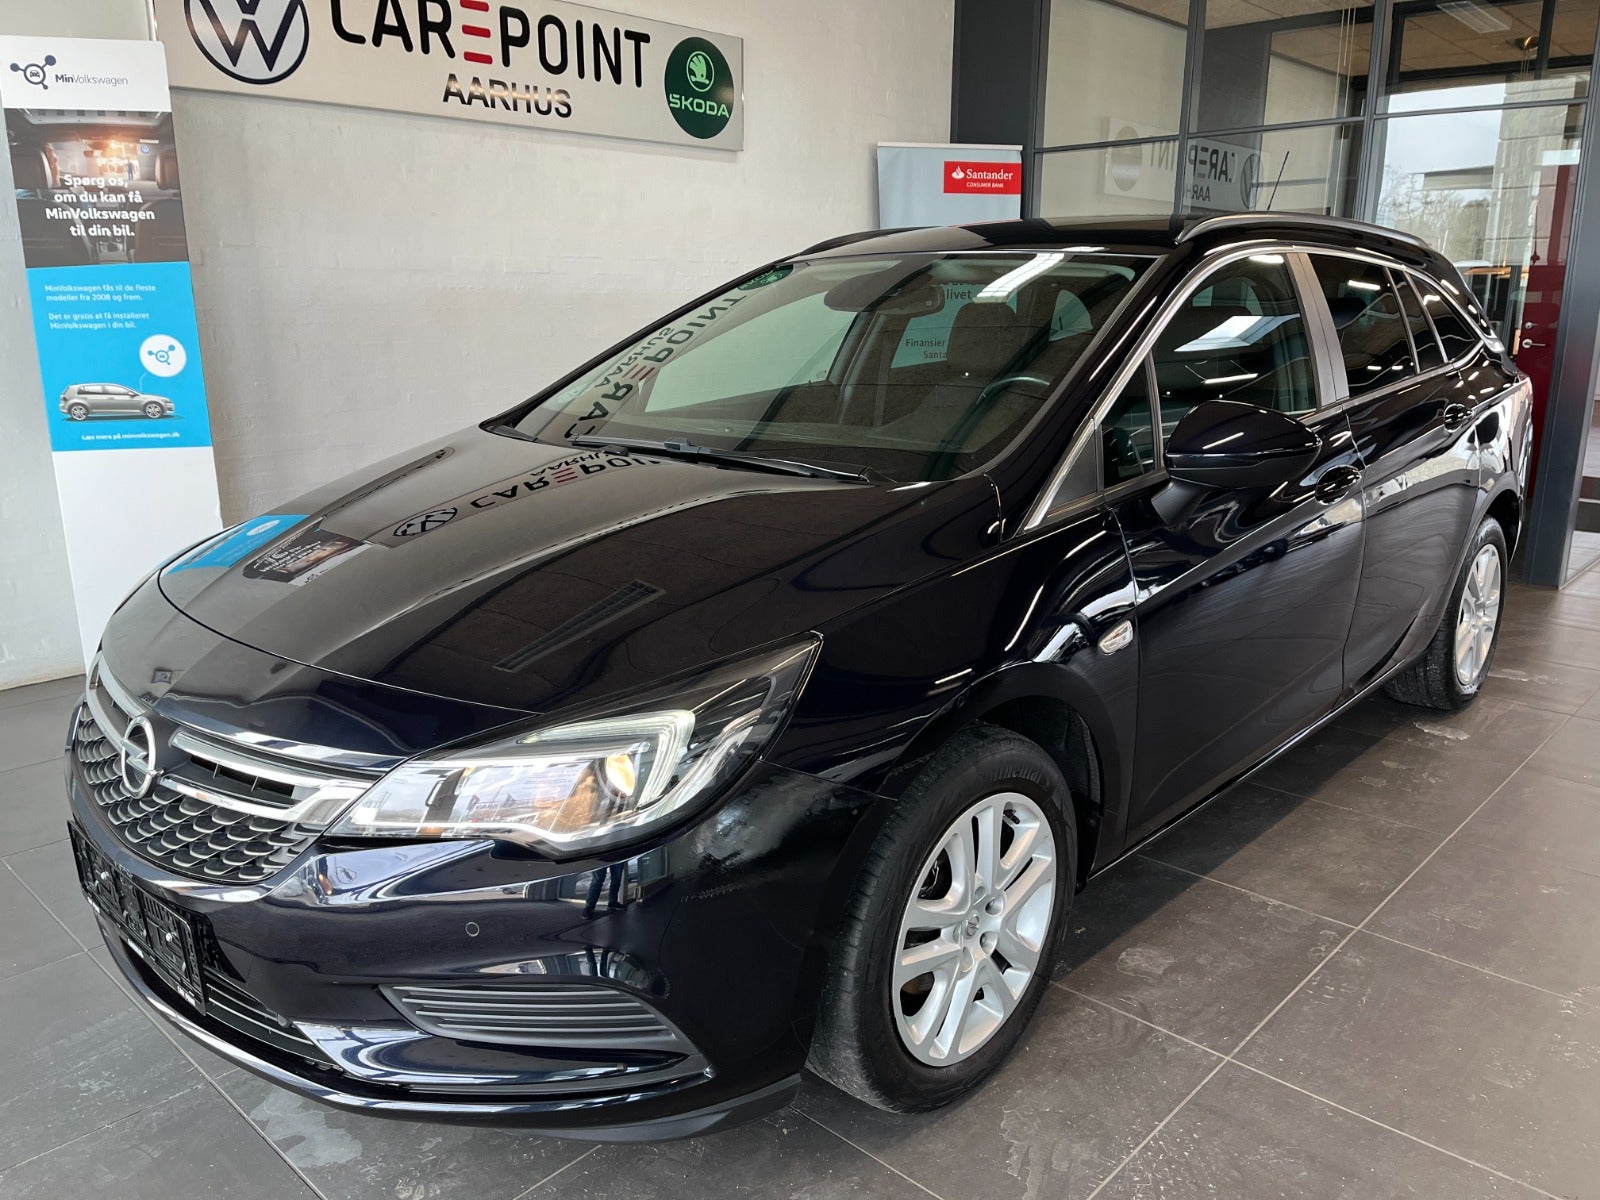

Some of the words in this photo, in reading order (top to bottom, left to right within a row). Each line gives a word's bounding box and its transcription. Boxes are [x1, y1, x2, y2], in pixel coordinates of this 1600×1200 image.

[330, 0, 651, 88] CAREPOINT
[55, 74, 129, 86] MinVolkswagen
[443, 72, 573, 119] AARHUS
[64, 174, 105, 187] Spørg
[109, 176, 129, 187] os,
[966, 168, 1013, 180] Santander
[54, 193, 77, 203] om
[80, 191, 97, 203] du
[101, 191, 124, 203] kan
[128, 190, 143, 203] få
[45, 208, 155, 222] MinVolkswagen
[70, 224, 86, 236] til
[89, 224, 110, 236] din
[113, 224, 136, 236] bil.
[946, 289, 972, 300] livet
